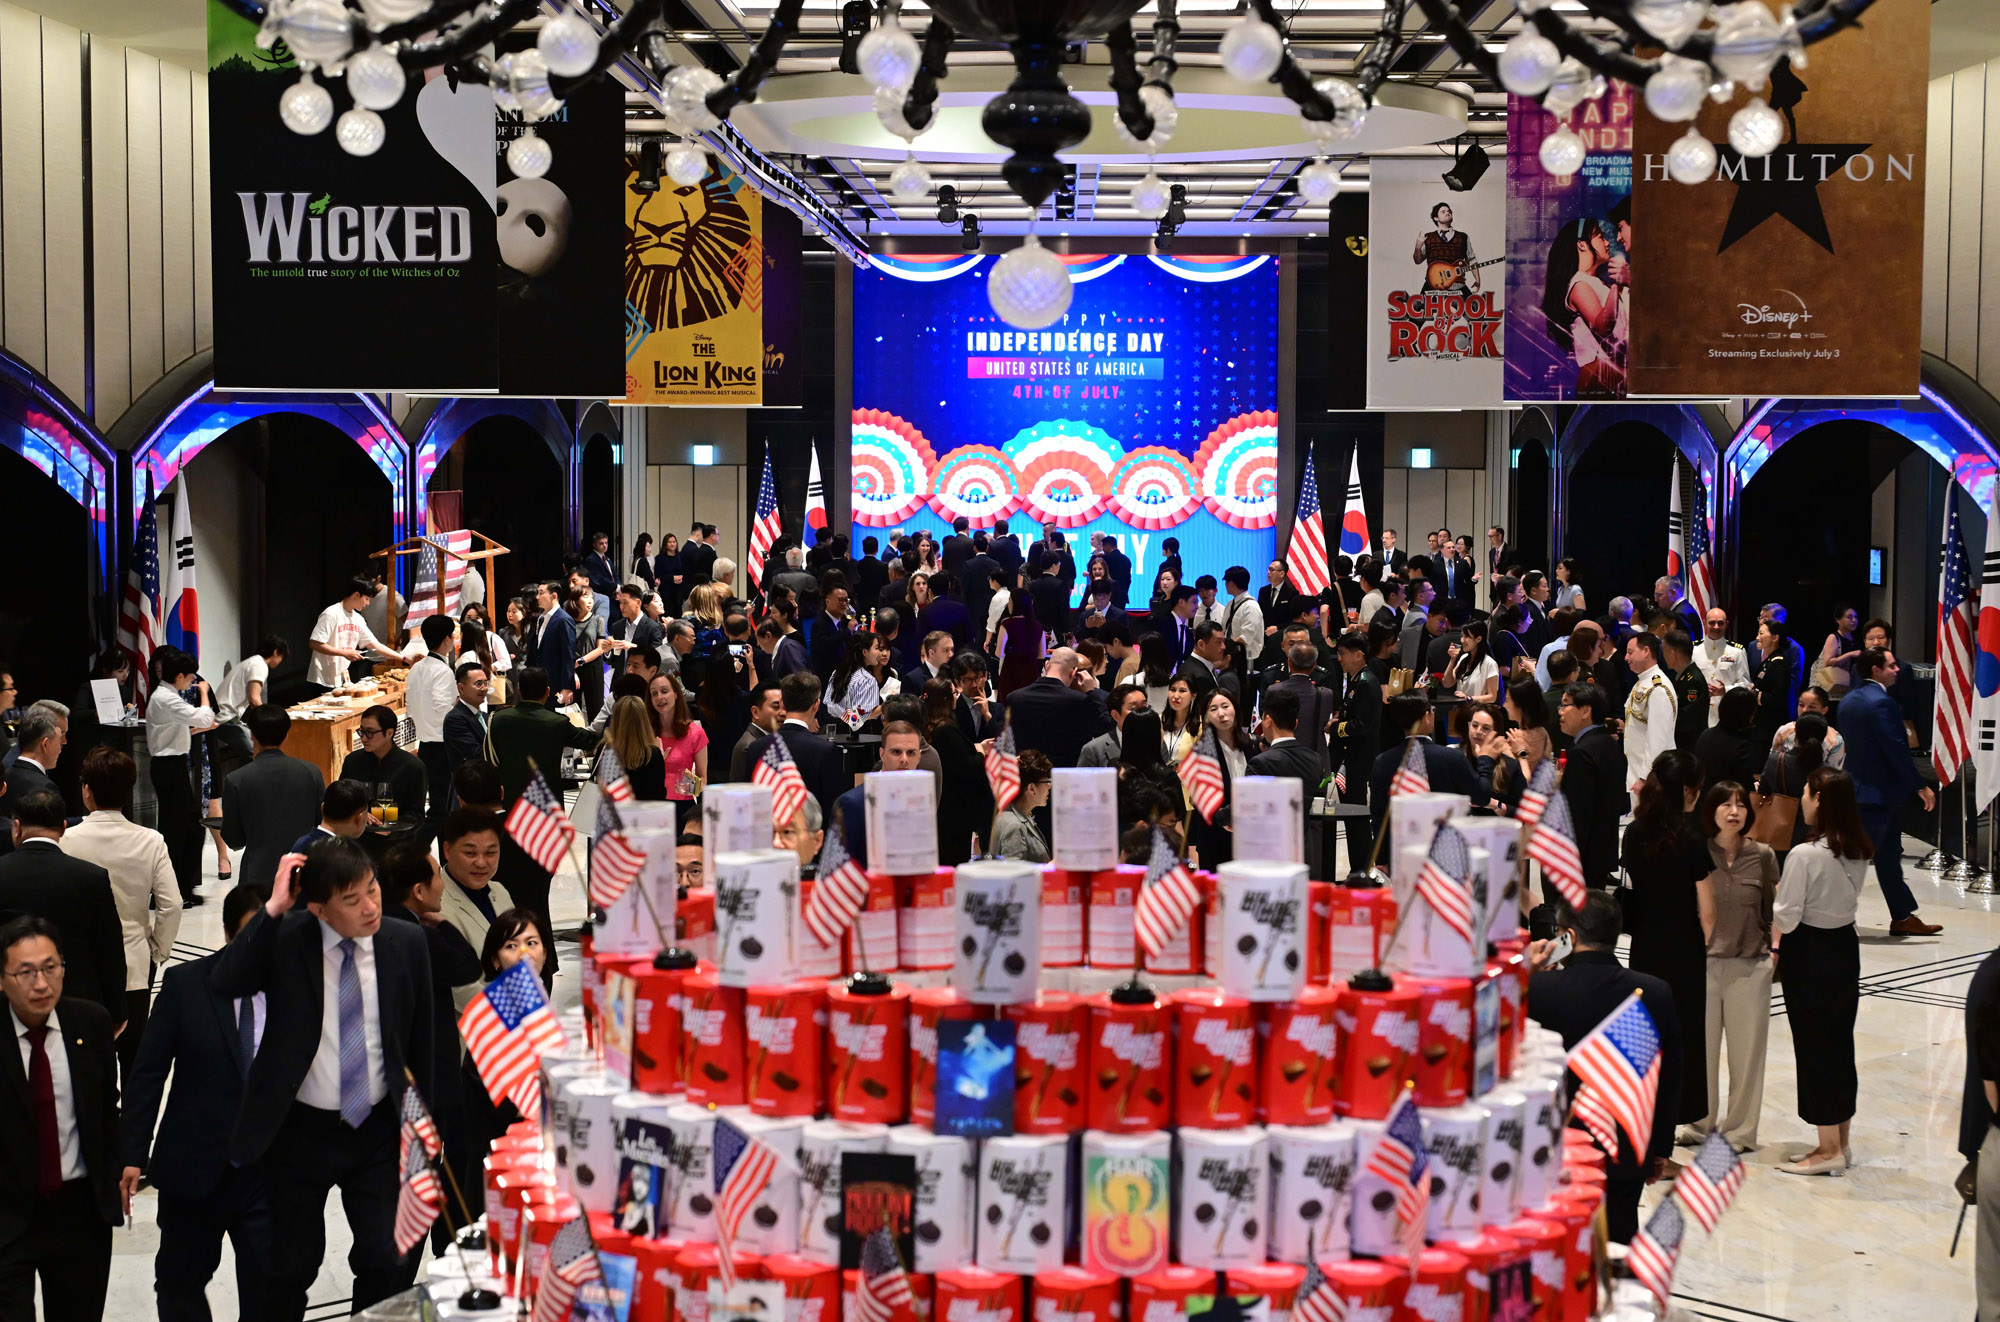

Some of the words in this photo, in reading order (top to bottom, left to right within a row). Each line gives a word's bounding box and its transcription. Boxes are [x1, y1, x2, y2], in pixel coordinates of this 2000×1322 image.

[1582, 167, 1603, 176] NEW
[1642, 153, 1915, 182] HMILTON
[250, 268, 269, 277] The
[272, 267, 304, 277] untold
[307, 269, 328, 277] true
[330, 269, 356, 279] story
[359, 267, 371, 277] of
[372, 267, 388, 277] the
[391, 267, 431, 277] Witches
[434, 267, 445, 277] of
[447, 268, 460, 277] Oz
[1388, 290, 1504, 320] SCHOOL
[1434, 313, 1458, 335] of
[692, 343, 715, 355] THE
[967, 332, 1117, 352] INDEPENDENCE
[1127, 333, 1164, 352] DAY
[1388, 320, 1504, 360] ROCK
[1708, 349, 1757, 359] Streaming
[1760, 349, 1811, 359] Exclusively
[1813, 349, 1832, 359] July
[1833, 349, 1840, 357] 3
[654, 360, 699, 388] LION
[704, 360, 757, 389] KING
[986, 361, 1025, 376] UNITED
[1030, 361, 1071, 376] STATES
[1076, 361, 1090, 376] OF
[1095, 361, 1146, 376] AMERICA
[1012, 384, 1043, 400] 4TH
[1052, 384, 1072, 400] OF
[1081, 385, 1120, 400] JULY
